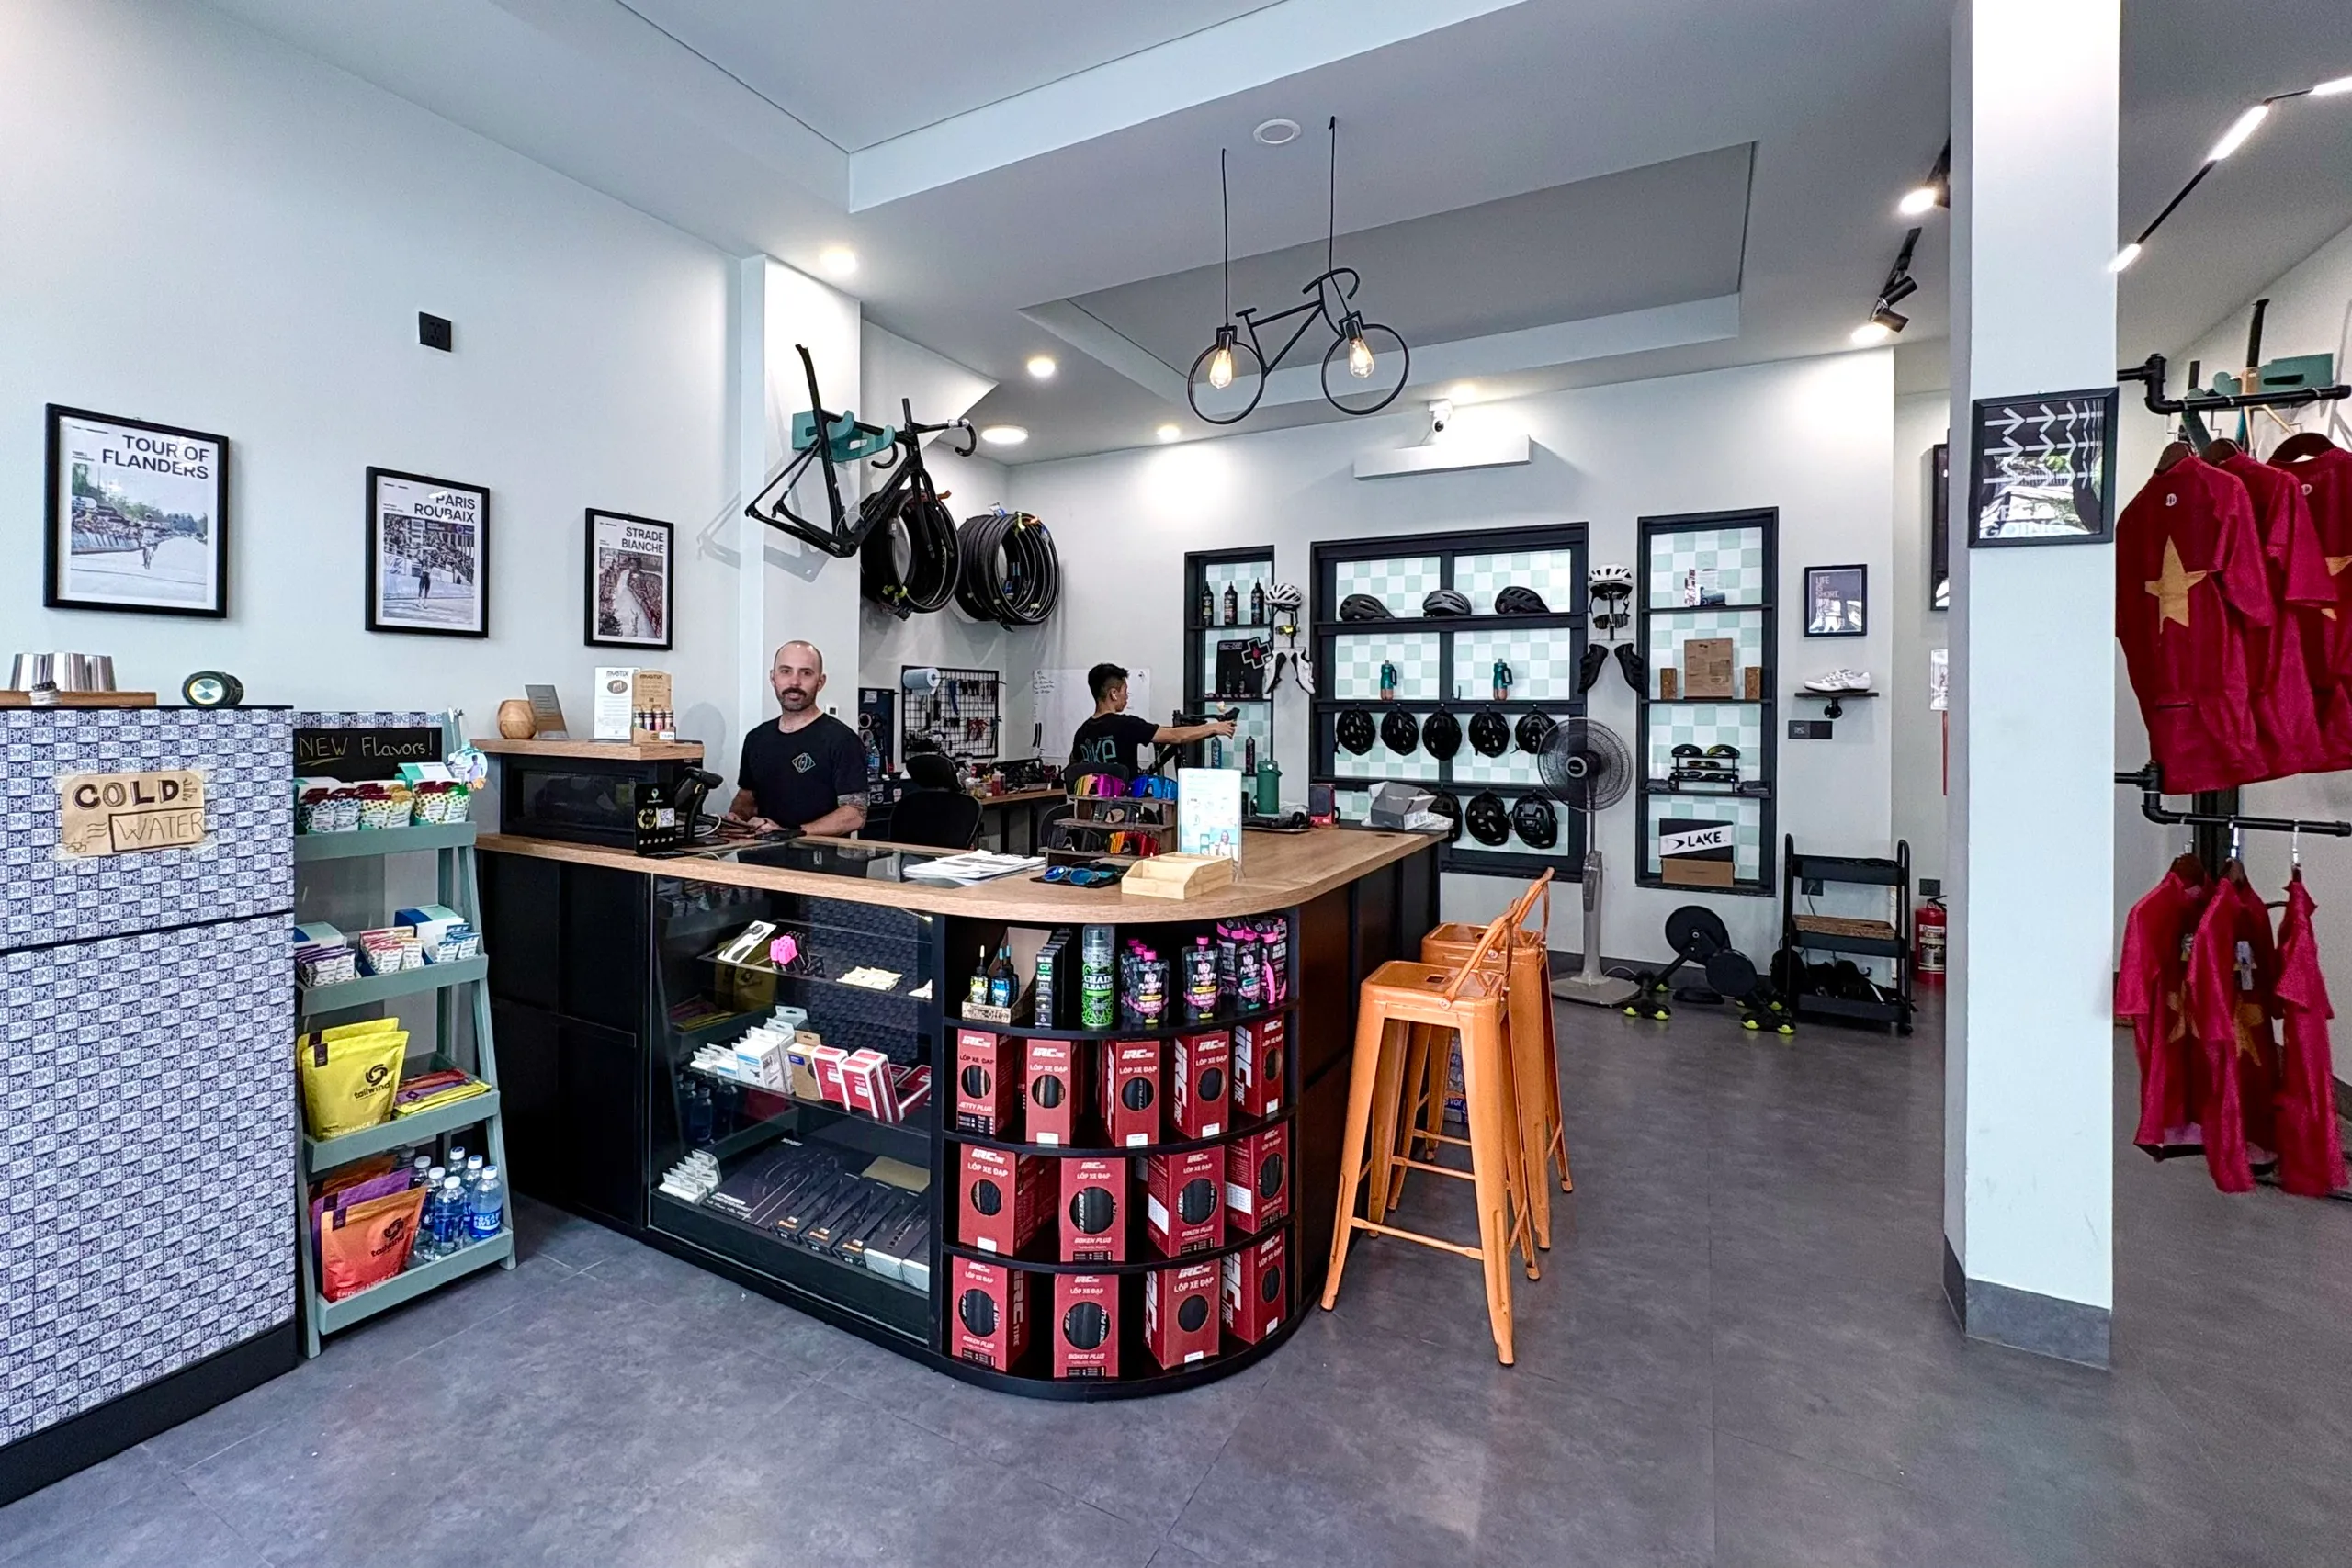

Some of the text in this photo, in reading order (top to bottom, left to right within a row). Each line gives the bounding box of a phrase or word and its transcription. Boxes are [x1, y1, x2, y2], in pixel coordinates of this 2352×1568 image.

[122, 434, 209, 462] TOUR OF
[102, 448, 209, 479] FLANDERS
[436, 494, 475, 510] PARIS
[414, 503, 474, 524] ROUBAIX
[626, 526, 664, 543] STRADE
[621, 538, 664, 554] BIANCHE
[299, 732, 434, 757] NEW Flavors!
[73, 779, 179, 809] COLD
[115, 811, 204, 840] WATER
[1688, 830, 1722, 847] LAKE
[354, 1080, 390, 1099] tailwind
[1189, 1280, 1199, 1290] XE
